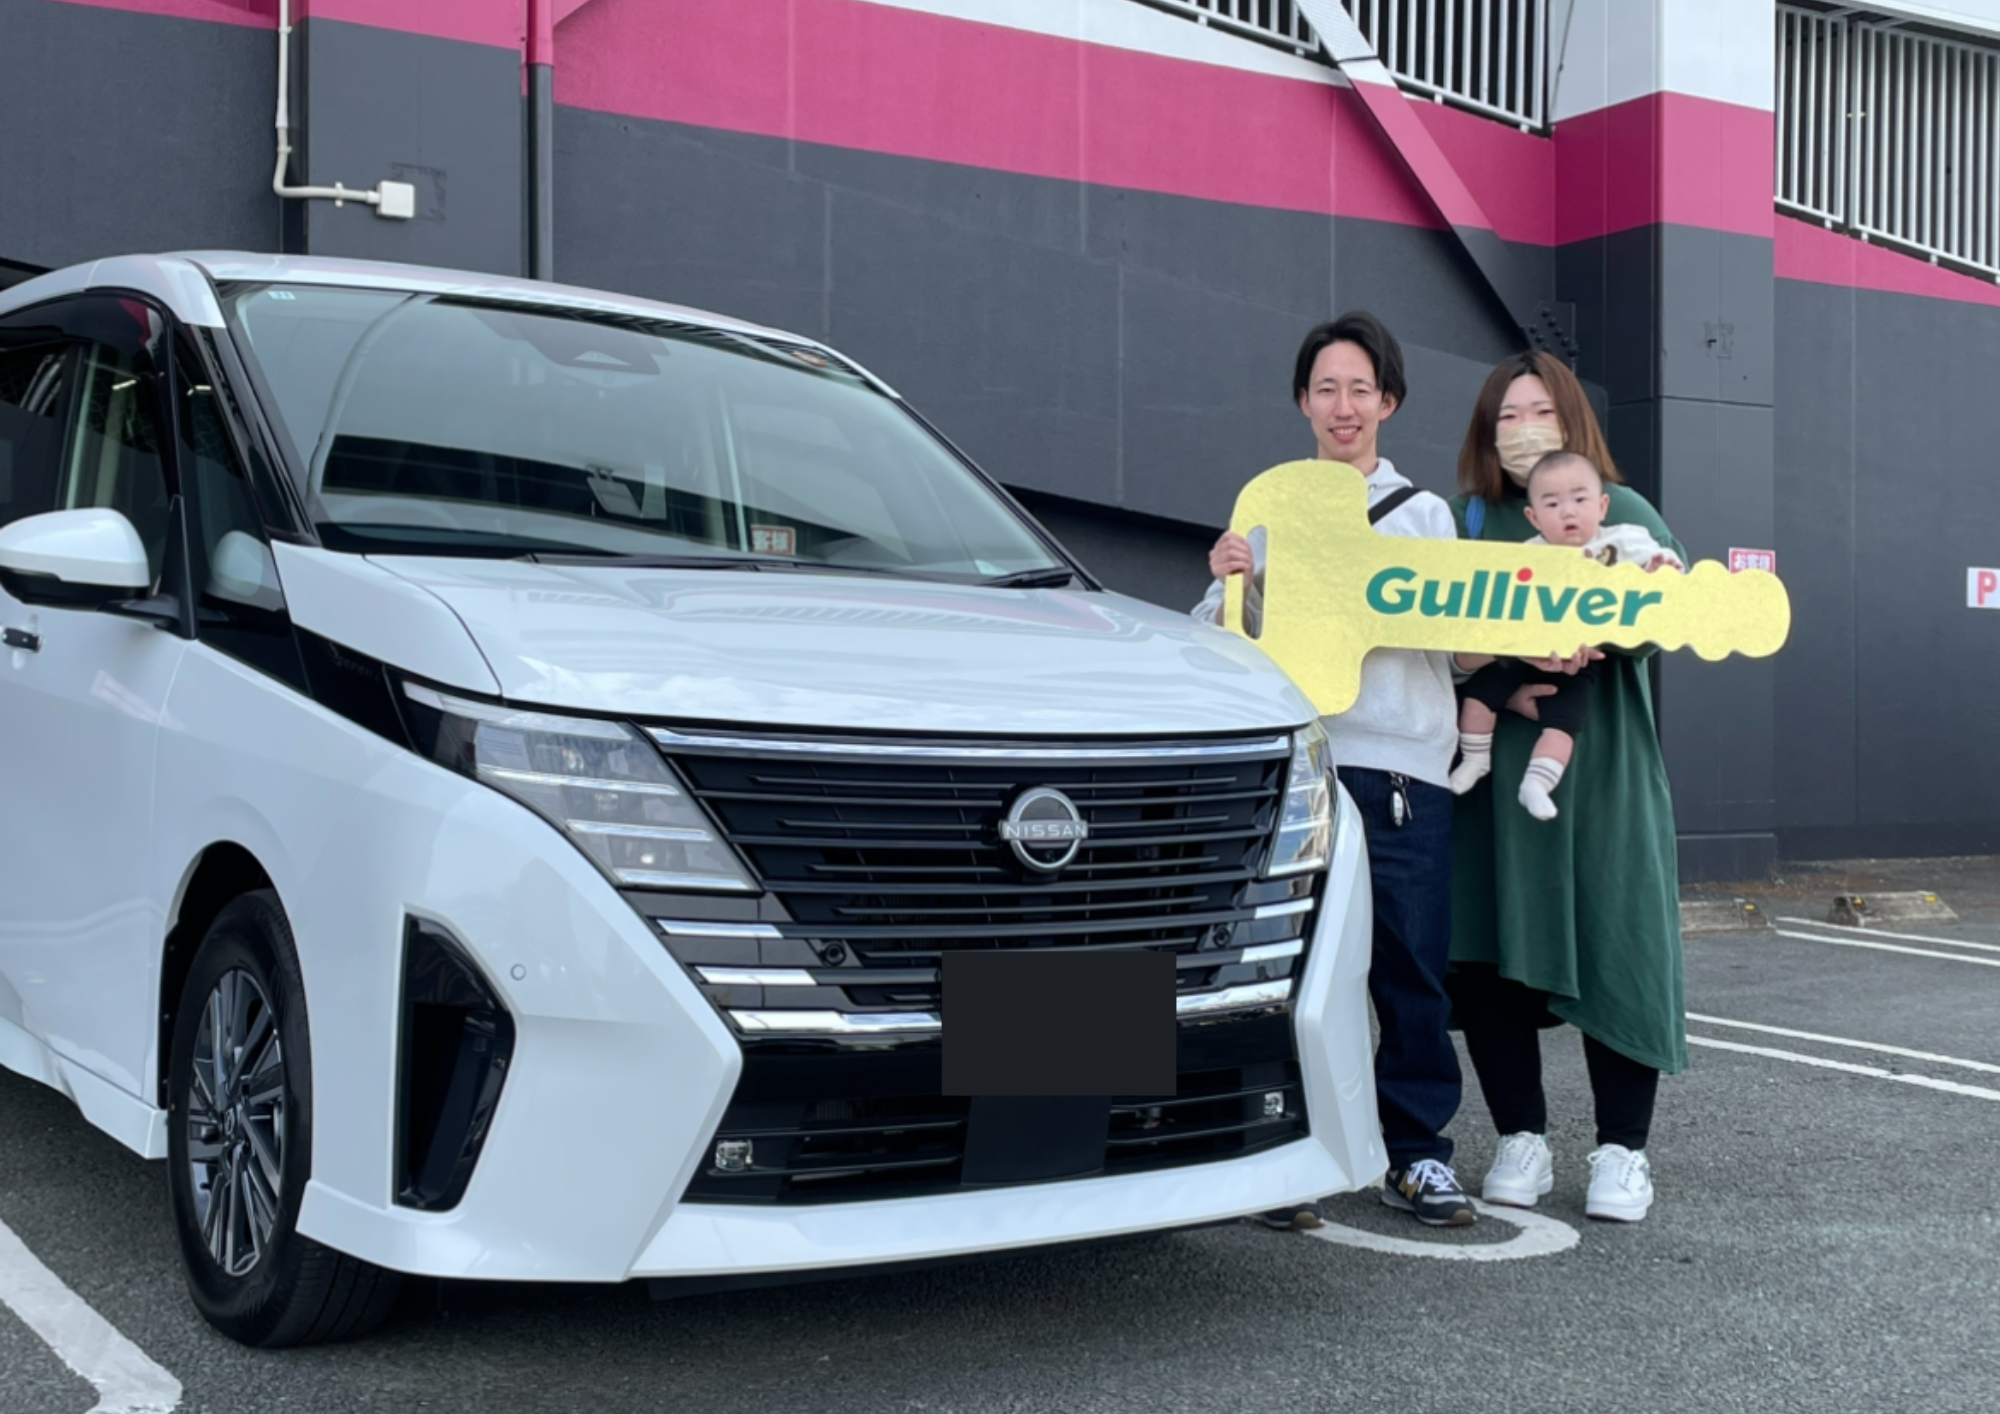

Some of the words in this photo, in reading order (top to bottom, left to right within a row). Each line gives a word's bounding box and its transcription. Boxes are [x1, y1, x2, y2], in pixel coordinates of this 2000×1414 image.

[1366, 566, 1663, 627] Gulliver
[1976, 571, 1998, 606] P
[1005, 823, 1086, 838] NISSAN
